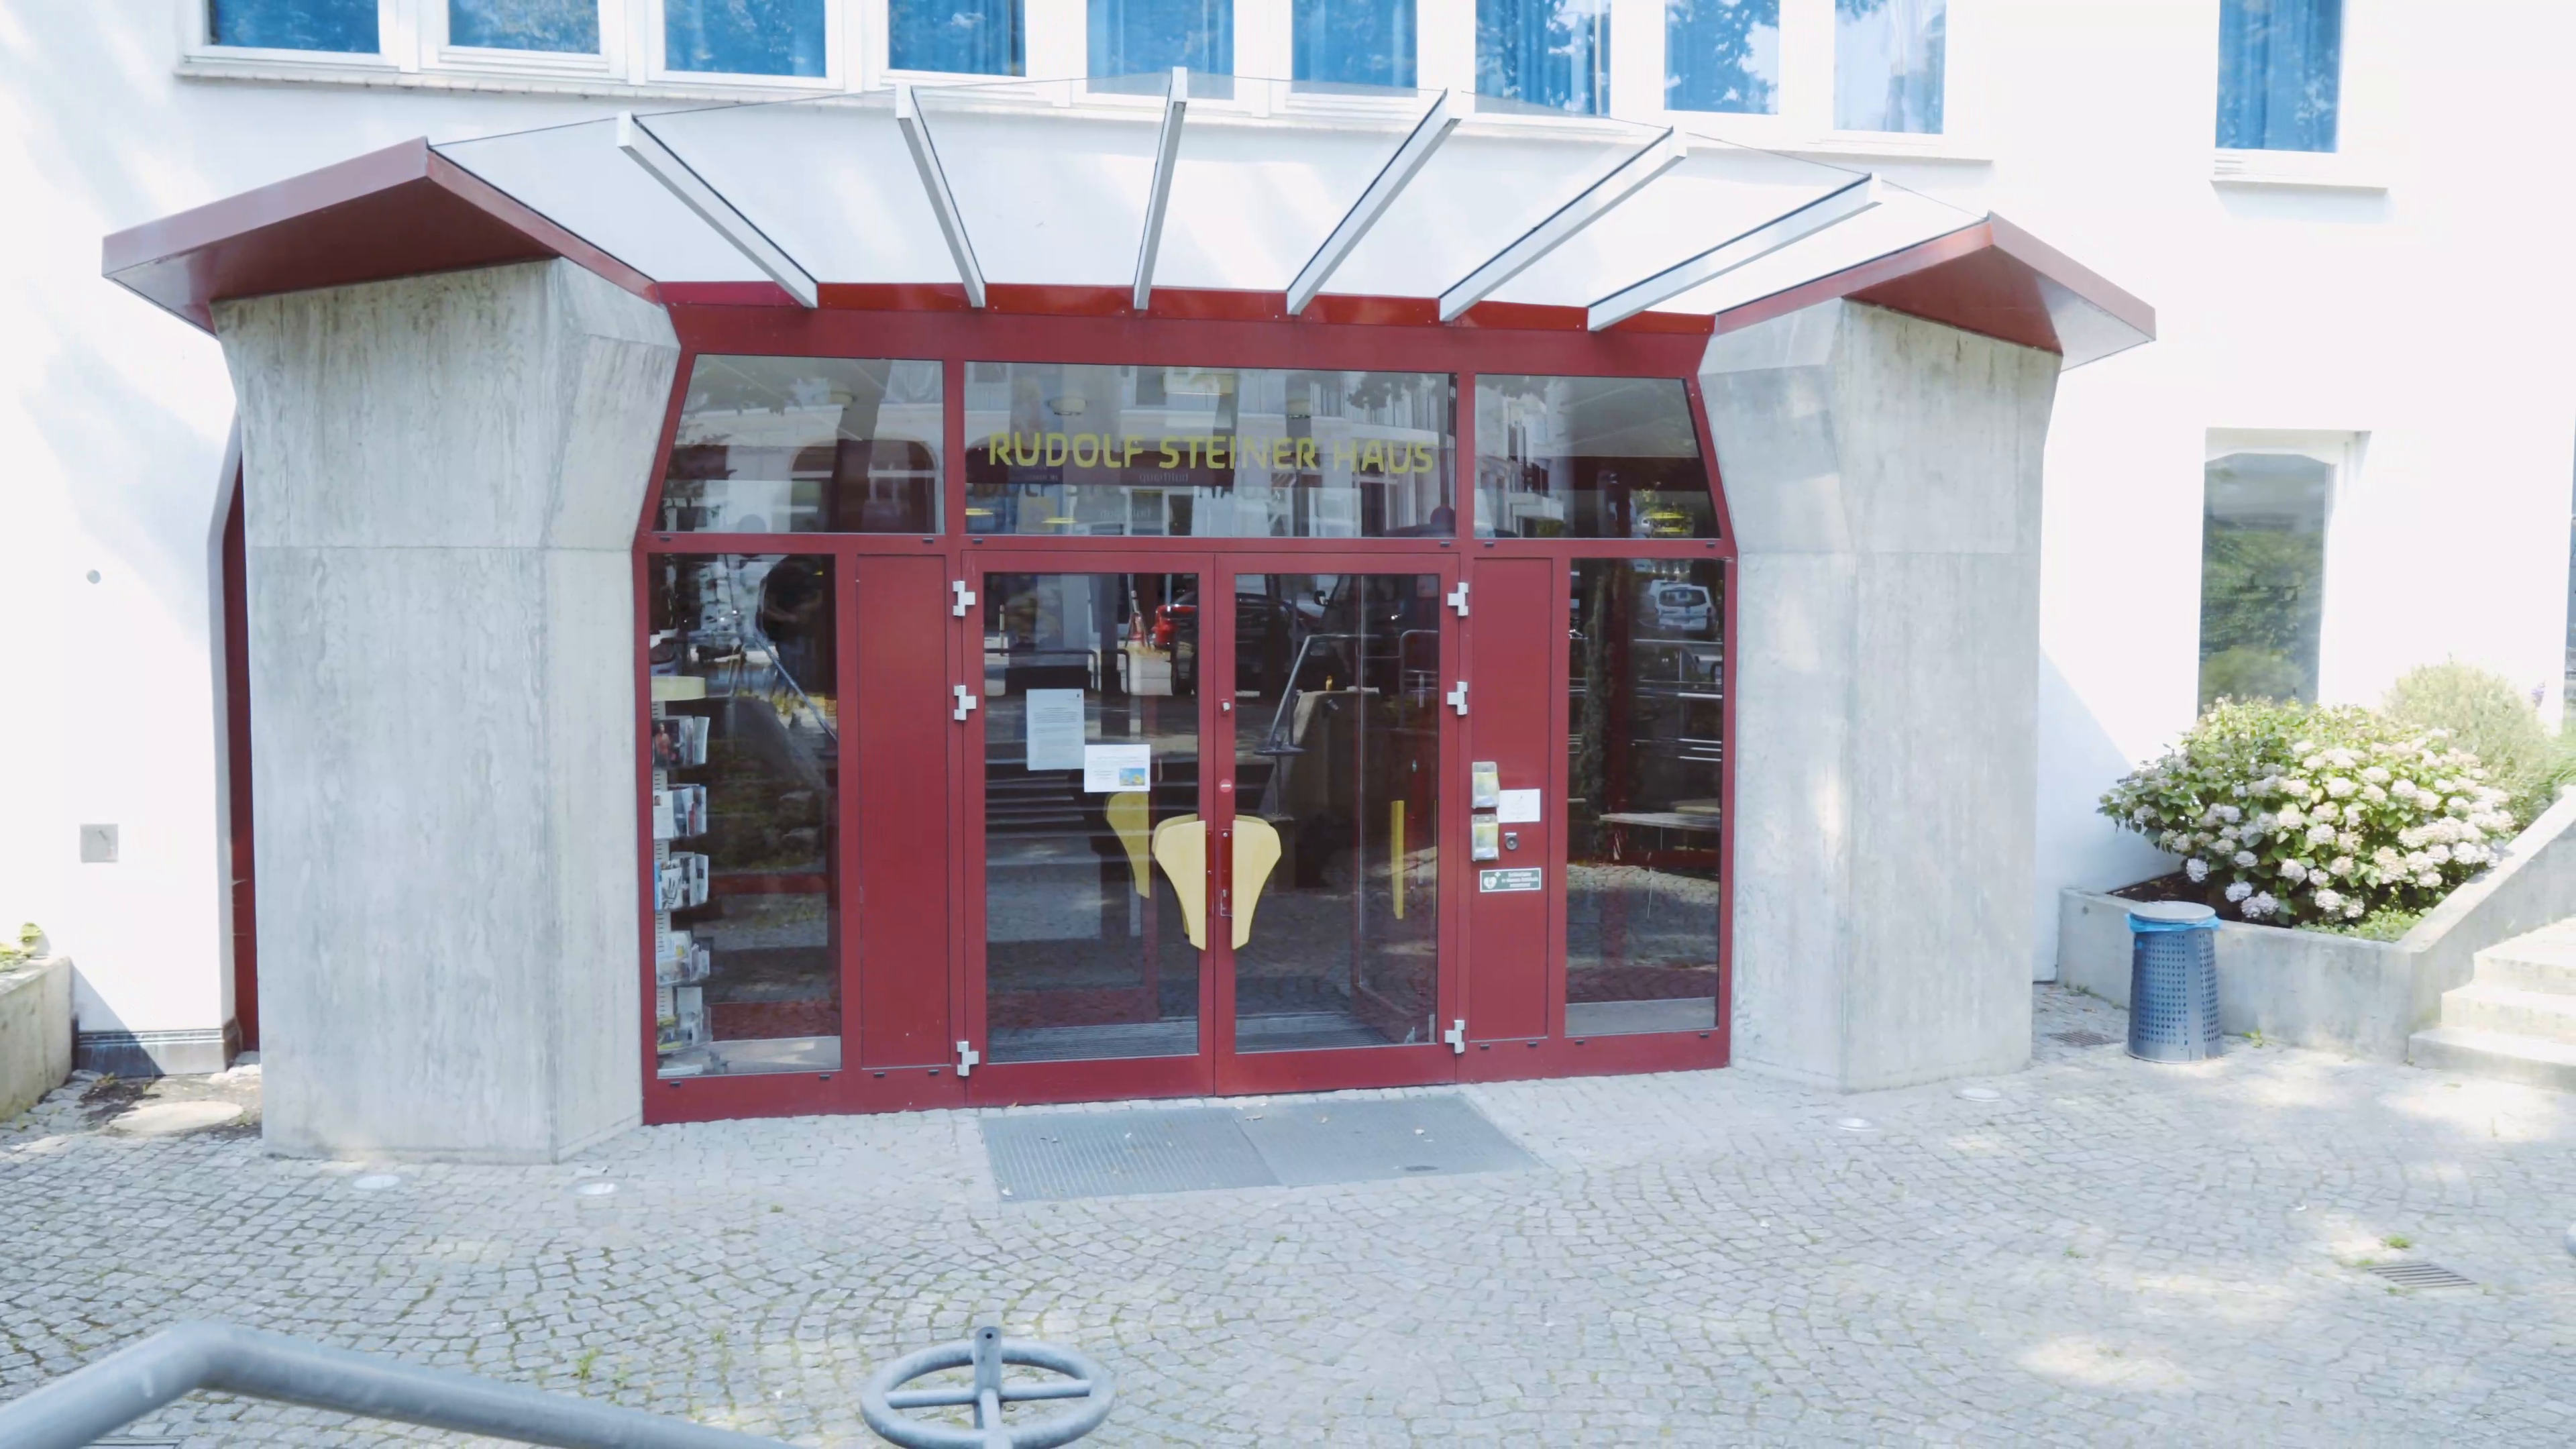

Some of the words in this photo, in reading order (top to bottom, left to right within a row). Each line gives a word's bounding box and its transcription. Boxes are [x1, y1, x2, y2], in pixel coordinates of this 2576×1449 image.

[989, 432, 1143, 468] RUDOLF
[1159, 435, 1318, 470] STEINER
[1333, 437, 1434, 474] HAUS
